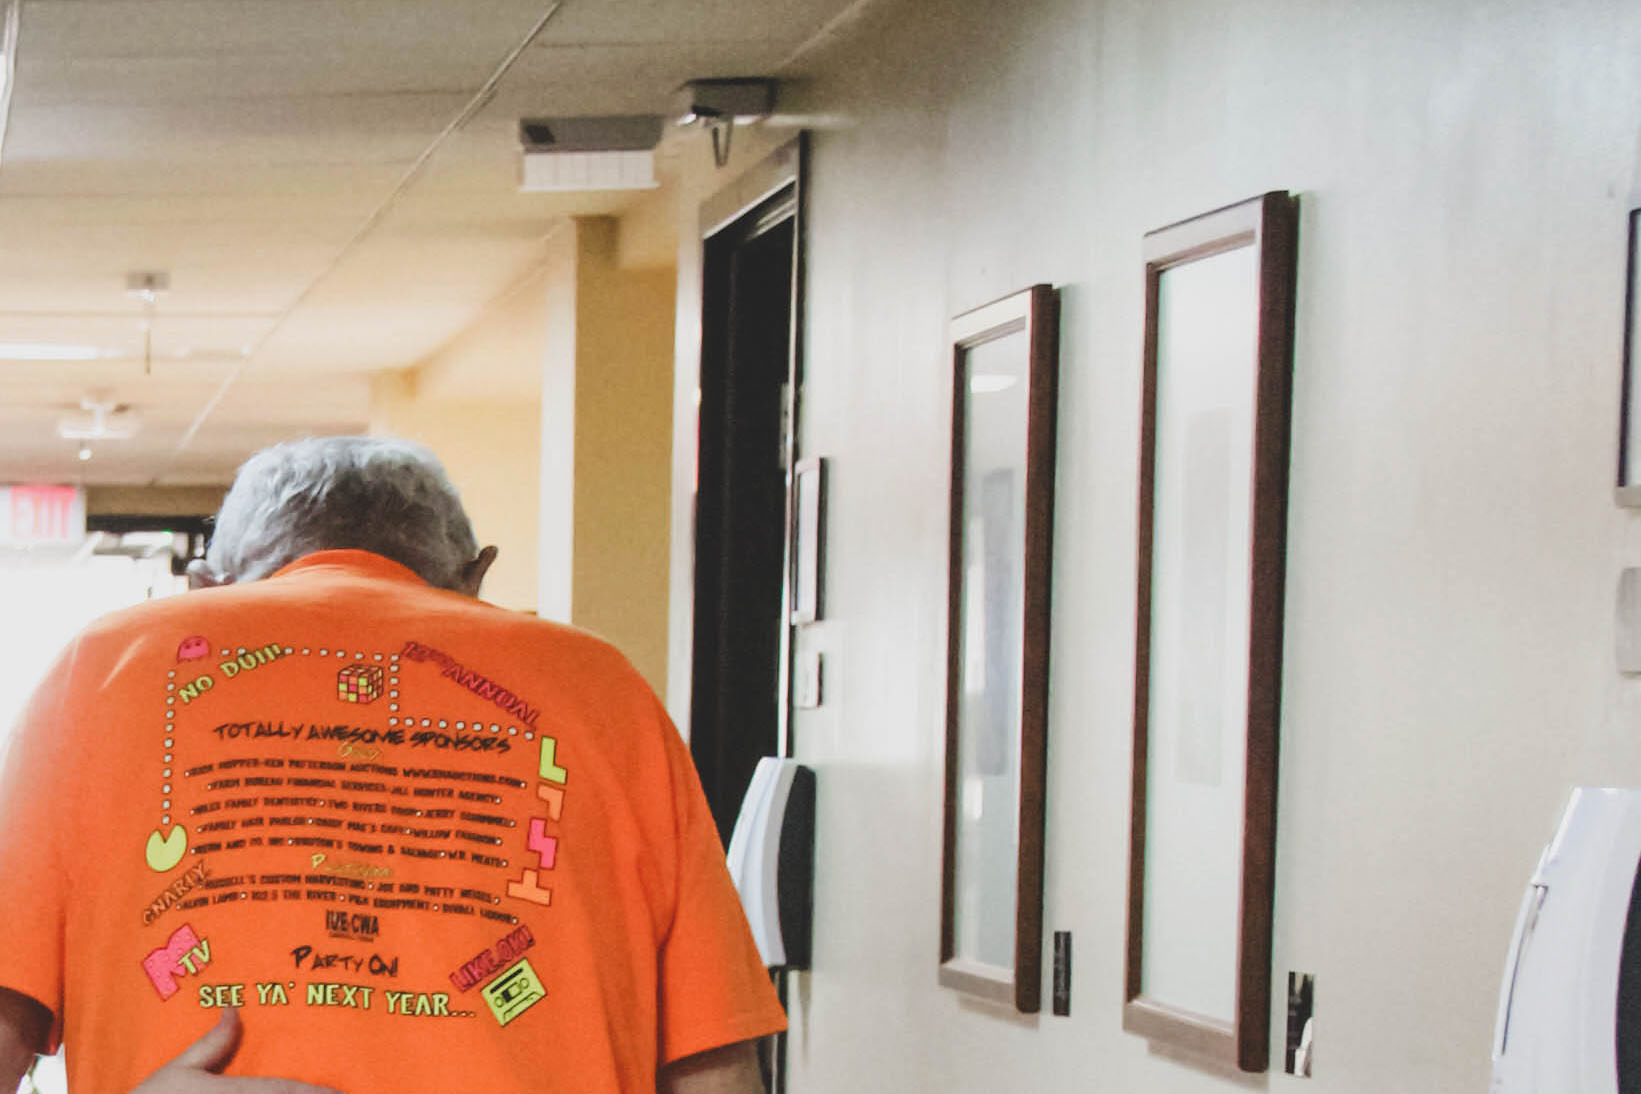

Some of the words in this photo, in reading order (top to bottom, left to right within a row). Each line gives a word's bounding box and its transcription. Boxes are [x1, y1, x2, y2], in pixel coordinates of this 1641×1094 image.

[178, 674, 215, 704] NO
[213, 720, 304, 740] TOTALLY
[307, 724, 405, 746] AWESOME
[409, 729, 512, 754] SPONSORS
[290, 945, 364, 971] PARTY
[197, 984, 246, 1008] SEE
[305, 982, 375, 1010] NEXT
